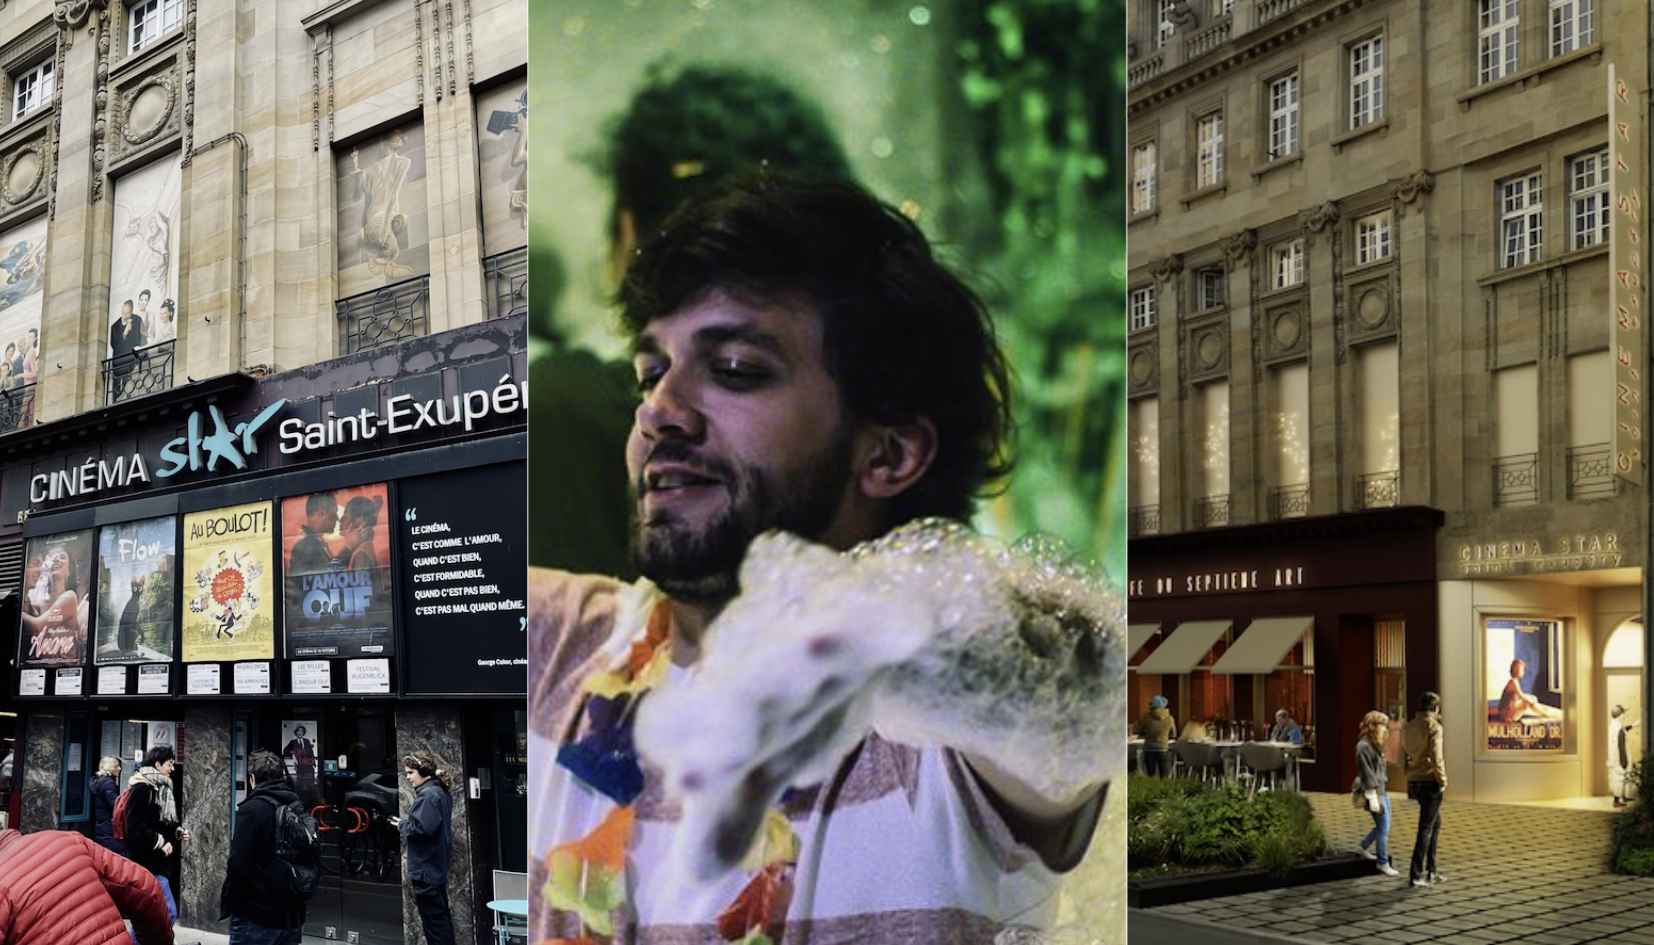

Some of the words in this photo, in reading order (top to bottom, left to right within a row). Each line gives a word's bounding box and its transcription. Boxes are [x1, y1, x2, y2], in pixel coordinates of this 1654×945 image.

[1617, 79, 1630, 214] STAR
[1617, 271, 1631, 474] CINEMA
[30, 452, 151, 503] CINÉMA
[411, 526, 420, 535] LE
[420, 522, 451, 534] CINÉMA,
[118, 538, 160, 562] Flow
[412, 540, 433, 551] C'EST
[433, 537, 463, 549] COMME
[464, 532, 502, 546] L'AMOUR,
[1460, 541, 1543, 562] CINEMA
[1559, 533, 1618, 555] STAR
[413, 556, 438, 568] QUAND
[439, 554, 461, 565] C'EST
[461, 552, 482, 563] BIEN,
[302, 570, 372, 592] L'AMOUR
[413, 573, 435, 583] C'EST
[435, 568, 485, 581] FORMIDABLE,
[1274, 566, 1304, 587] ART
[414, 589, 440, 601] QUAND
[441, 587, 463, 598] C'EST
[463, 585, 479, 596] PAS
[479, 584, 500, 594] BIEN,
[302, 586, 374, 623] OUF
[415, 605, 436, 616] C'EST
[437, 604, 452, 614] PAS
[452, 603, 469, 613] MAL
[470, 602, 498, 614] QUAND
[498, 598, 526, 610] MÊME.
[351, 672, 387, 680] AUGENBLICK
[1488, 723, 1547, 739] MULHOLLAND
